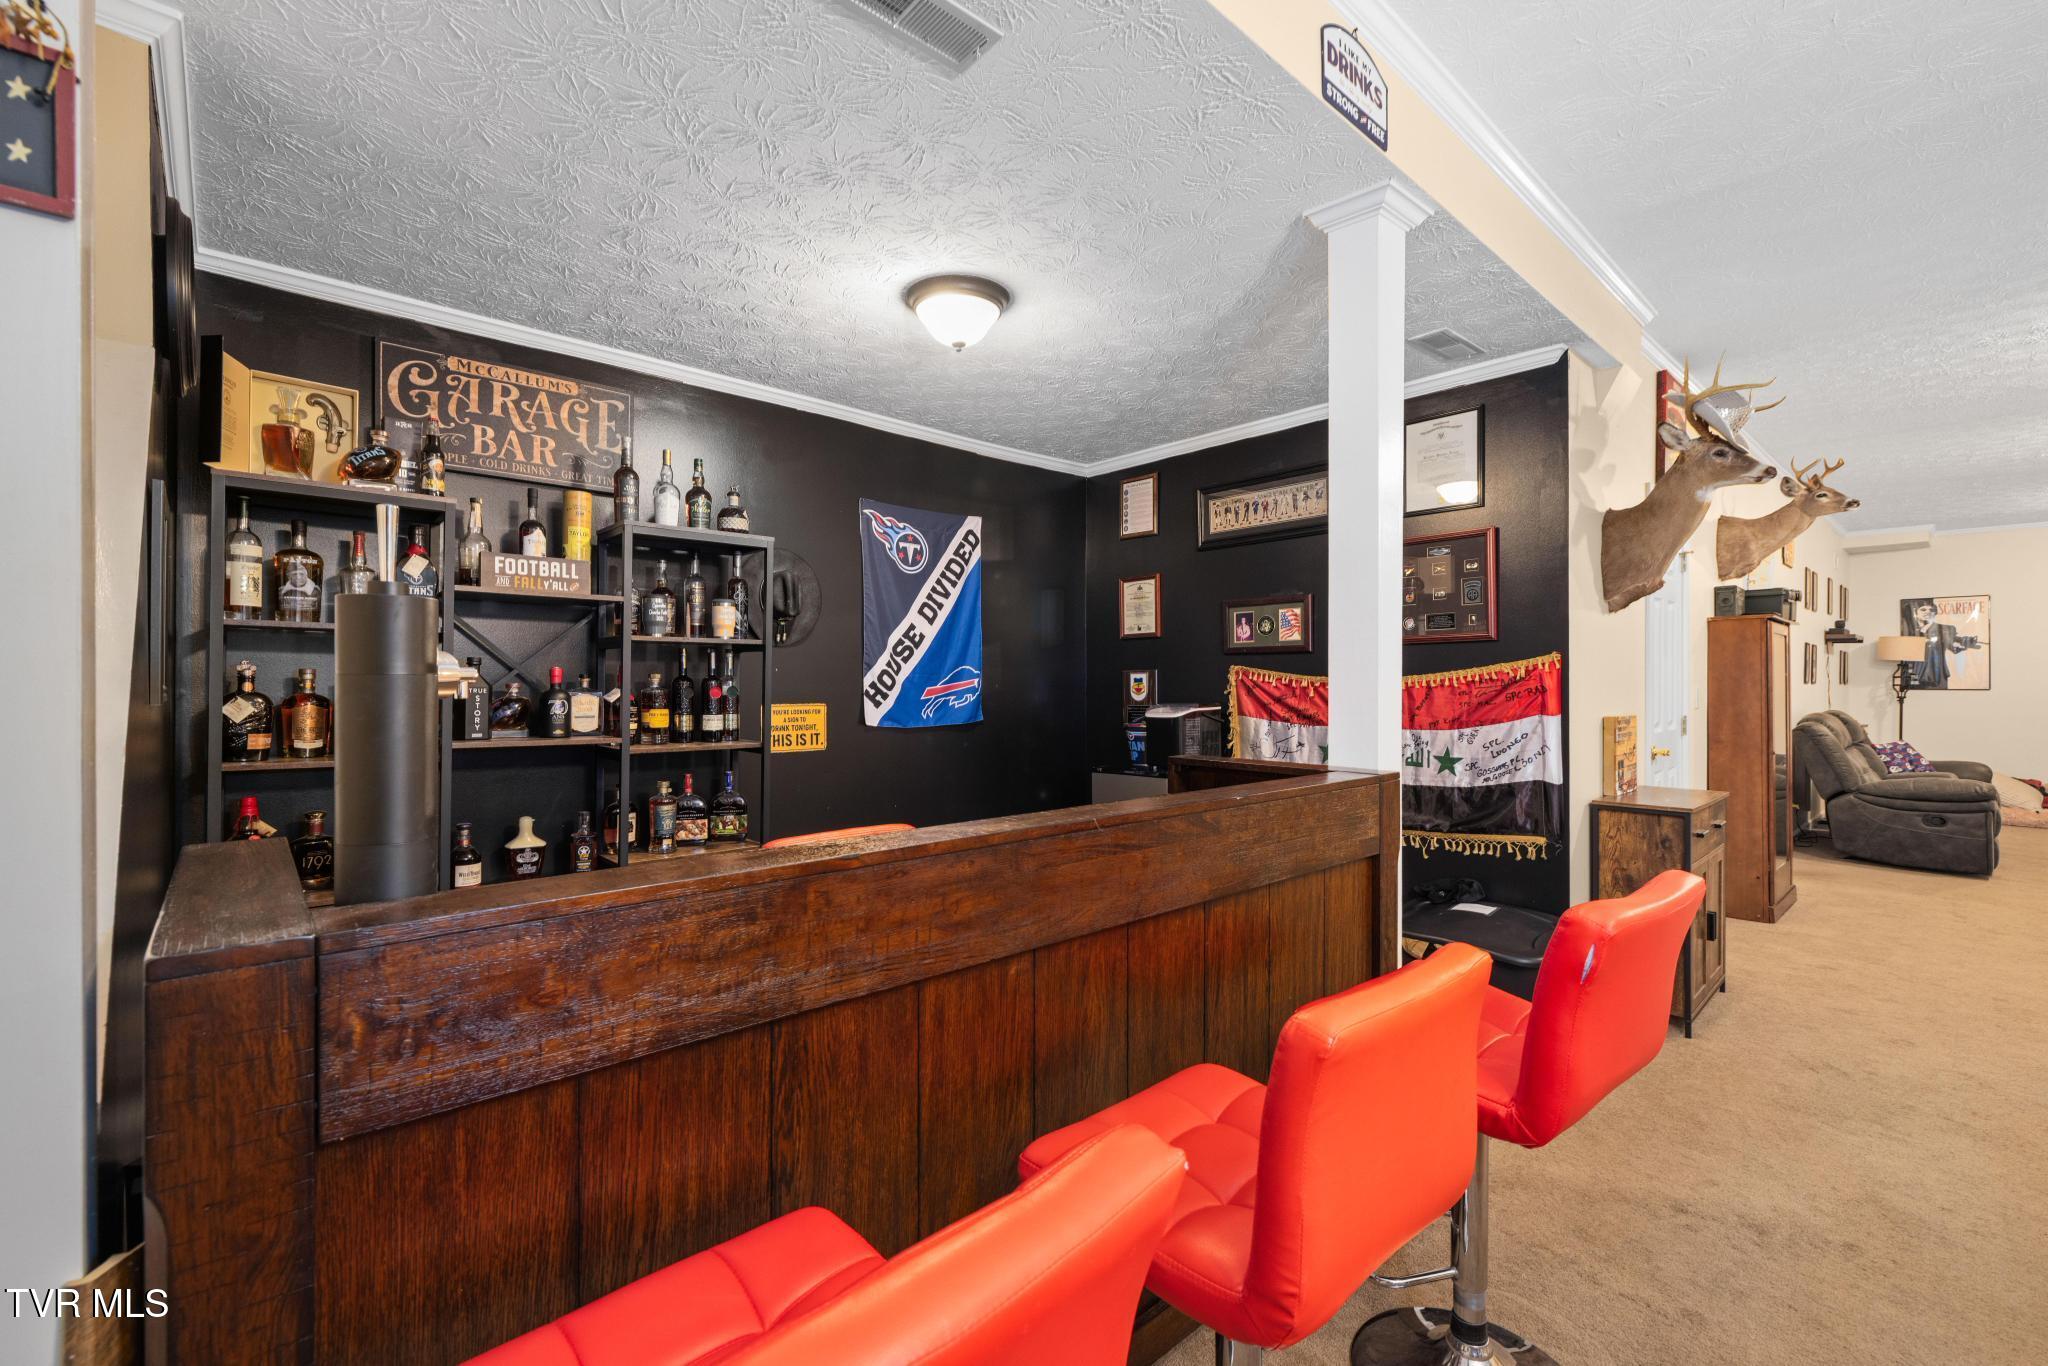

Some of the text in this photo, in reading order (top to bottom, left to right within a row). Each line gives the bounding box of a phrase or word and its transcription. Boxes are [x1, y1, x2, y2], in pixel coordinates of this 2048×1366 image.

[1327, 40, 1383, 110] DRINKS
[1326, 82, 1359, 120] STRONG
[1367, 118, 1385, 143] FREE
[387, 360, 626, 455] GARAGE
[348, 446, 387, 466] TITANS
[470, 423, 559, 468] BAR
[443, 452, 615, 487] PLE COLD DRINKS GREAT TIM
[494, 556, 580, 580] FOOTBALL
[496, 575, 569, 592] AND FALL Y'ALL
[408, 584, 434, 597] TANS
[864, 529, 981, 709] HOUSE DIVIDED
[474, 694, 482, 732] STORY
[772, 732, 824, 748] HIS IS IT.
[302, 854, 332, 870] 1792
